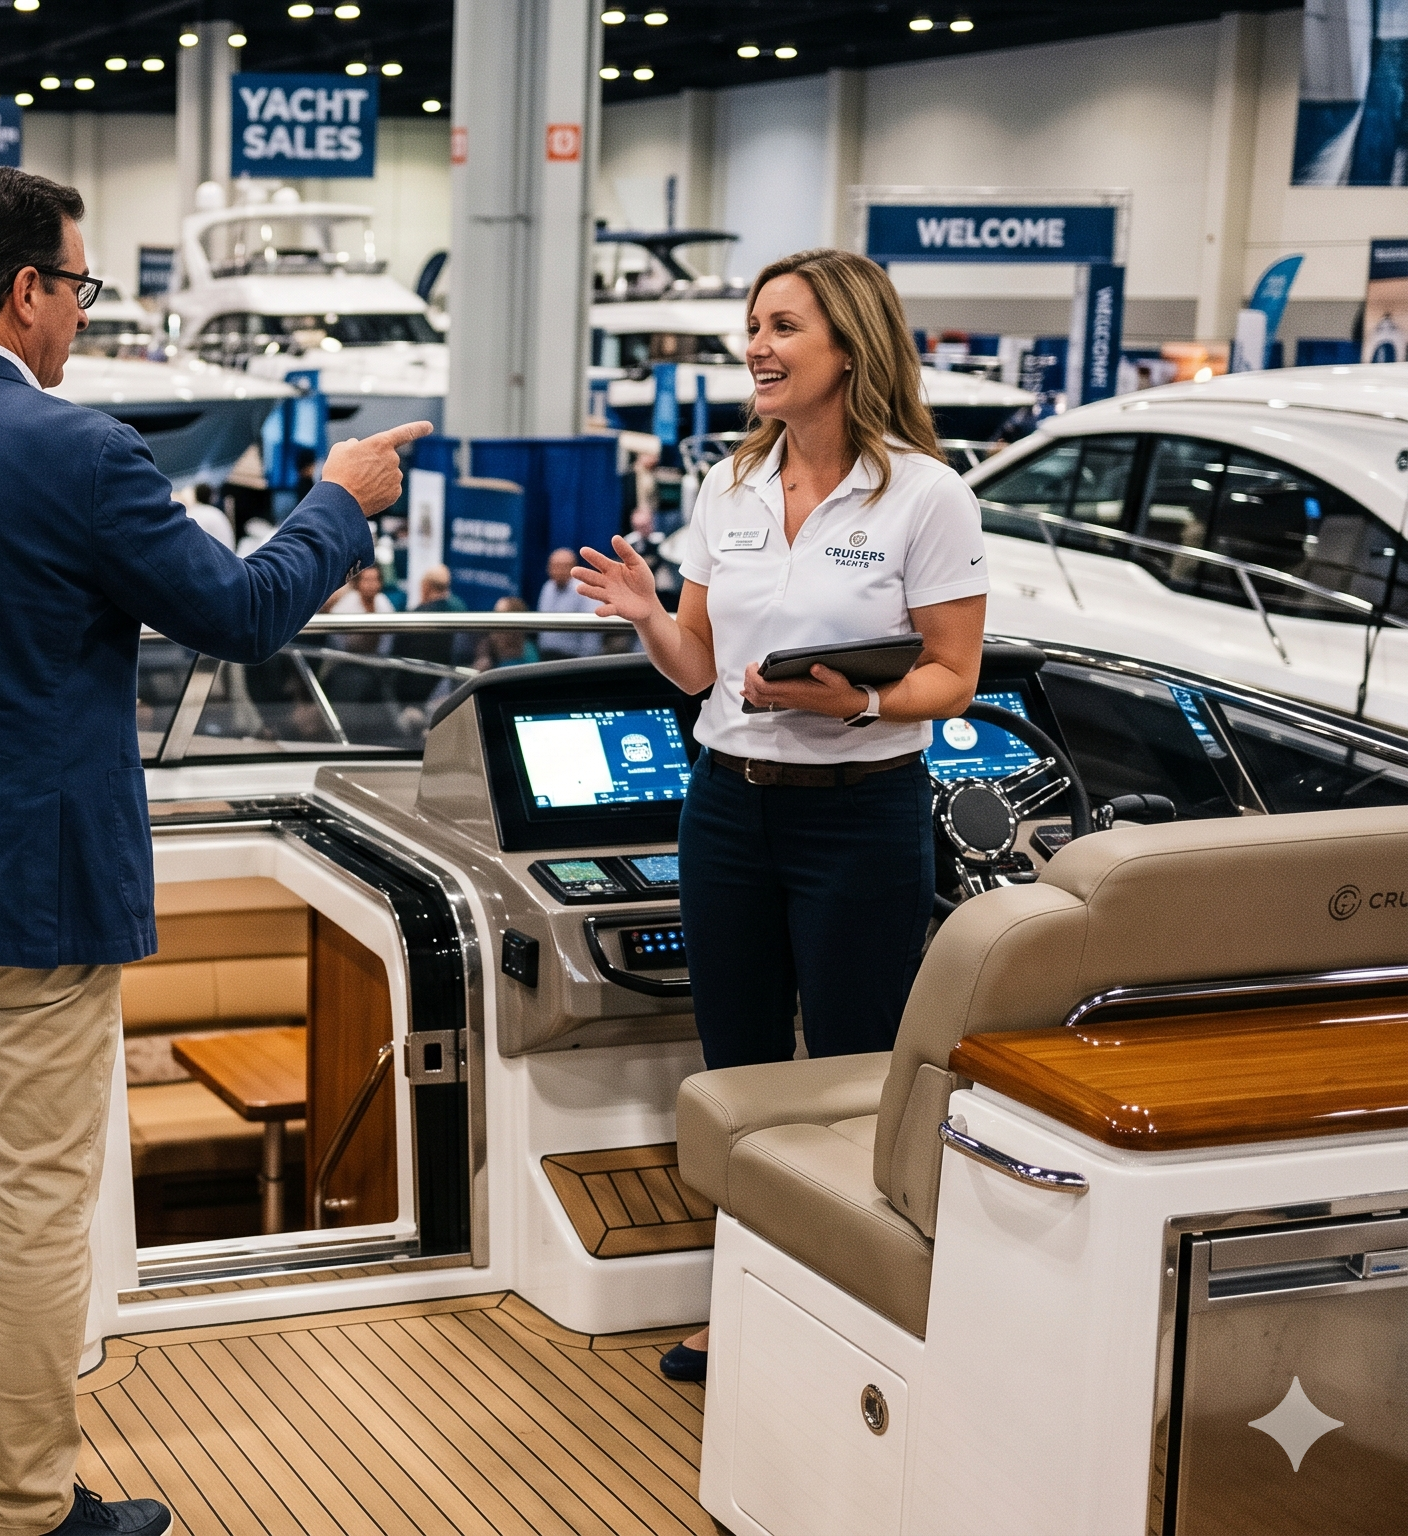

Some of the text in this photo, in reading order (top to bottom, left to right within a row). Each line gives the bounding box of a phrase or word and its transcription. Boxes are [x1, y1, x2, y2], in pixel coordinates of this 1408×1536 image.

[240, 87, 369, 123] YACHT
[243, 124, 363, 161] SALES
[917, 217, 1065, 248] WELCOME
[825, 546, 885, 562] CRUISERS
[835, 559, 870, 569] YACHTS
